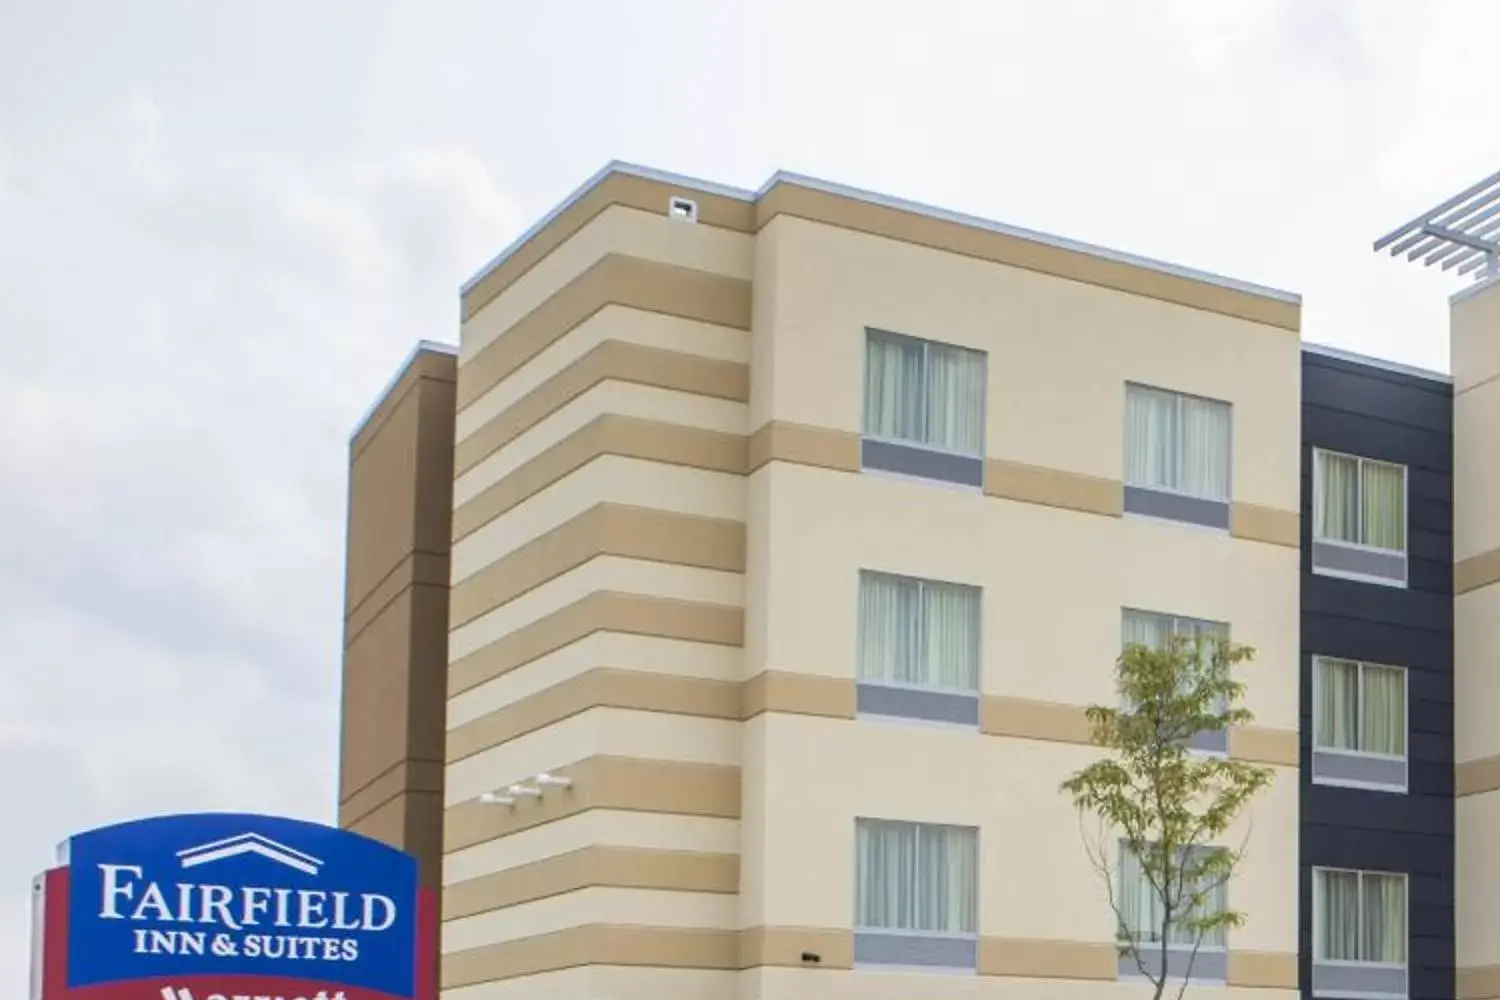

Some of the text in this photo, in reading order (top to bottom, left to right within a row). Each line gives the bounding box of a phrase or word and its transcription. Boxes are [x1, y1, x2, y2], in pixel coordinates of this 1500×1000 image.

[97, 863, 397, 931] FAIRFIELD
[134, 930, 359, 962] INN & SUITES
